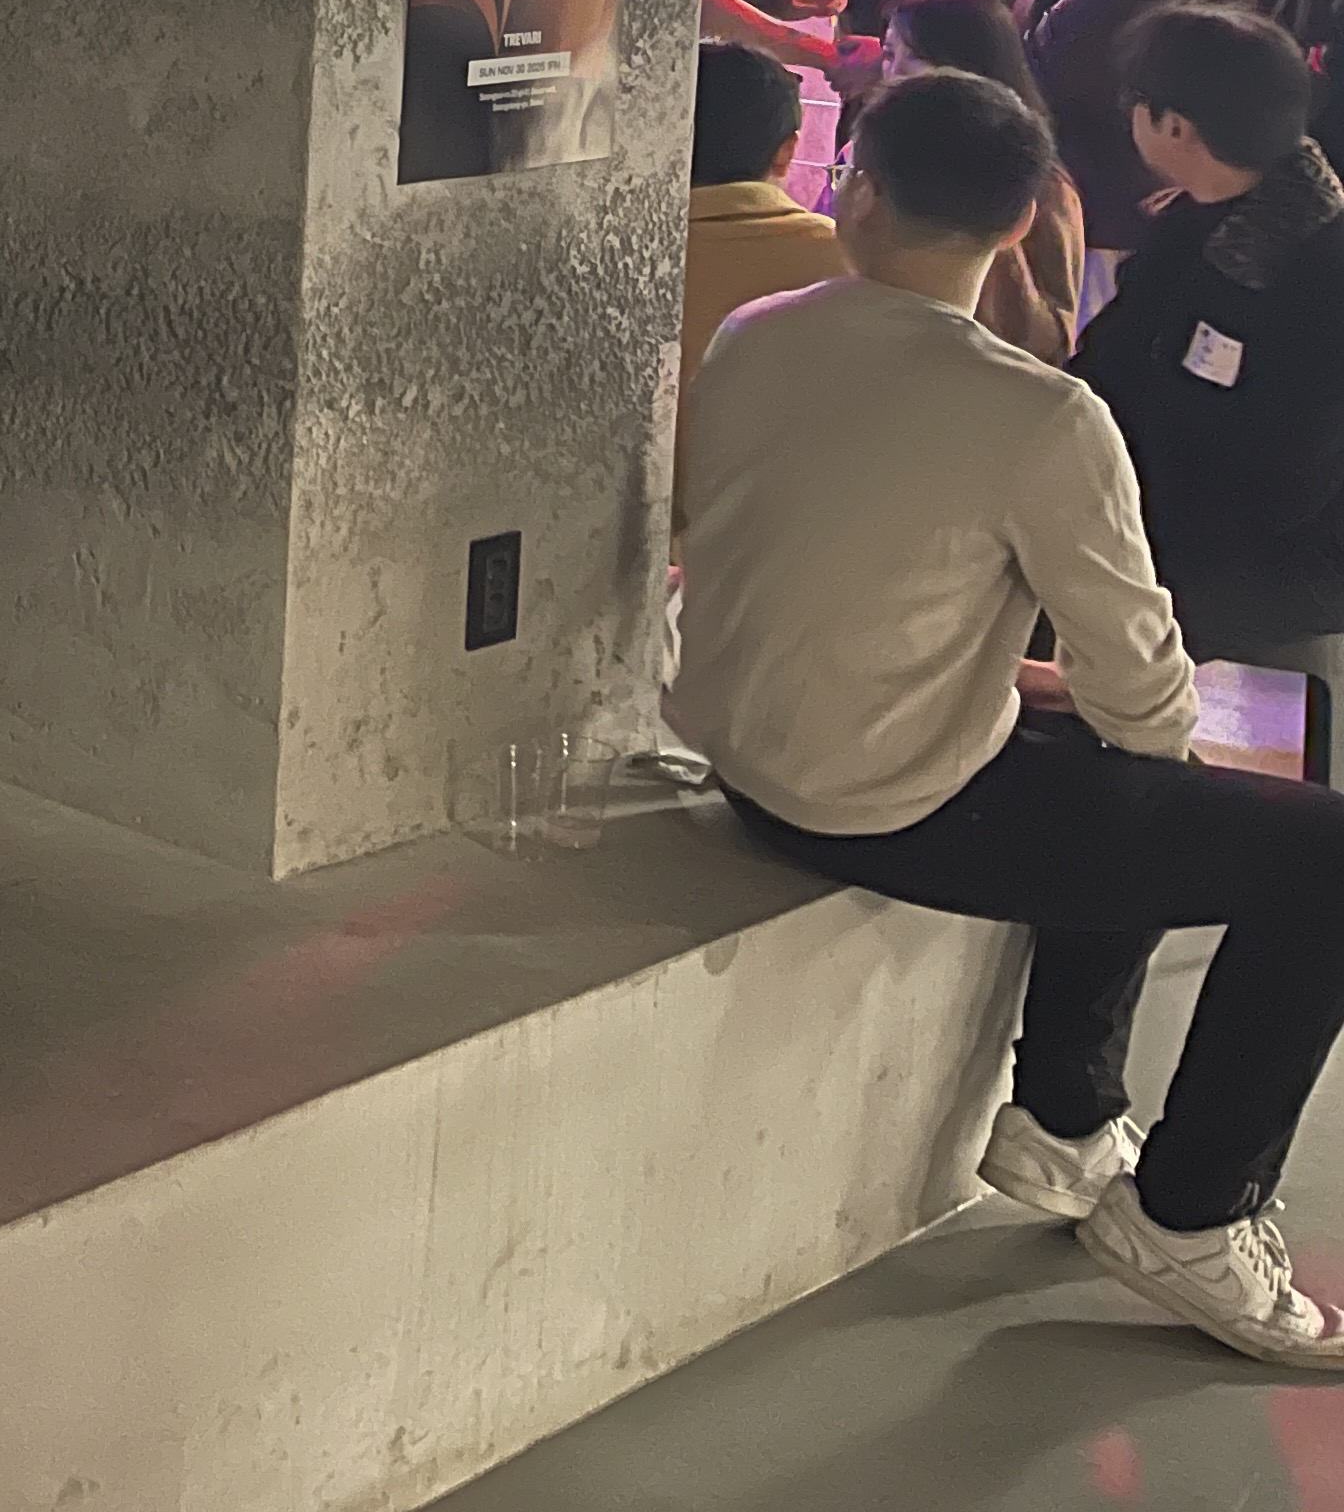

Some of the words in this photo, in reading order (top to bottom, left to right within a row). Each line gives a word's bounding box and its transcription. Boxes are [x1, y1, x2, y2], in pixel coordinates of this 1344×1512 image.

[503, 31, 542, 47] TREVARI
[479, 67, 496, 78] SUN
[497, 65, 514, 75] NOV
